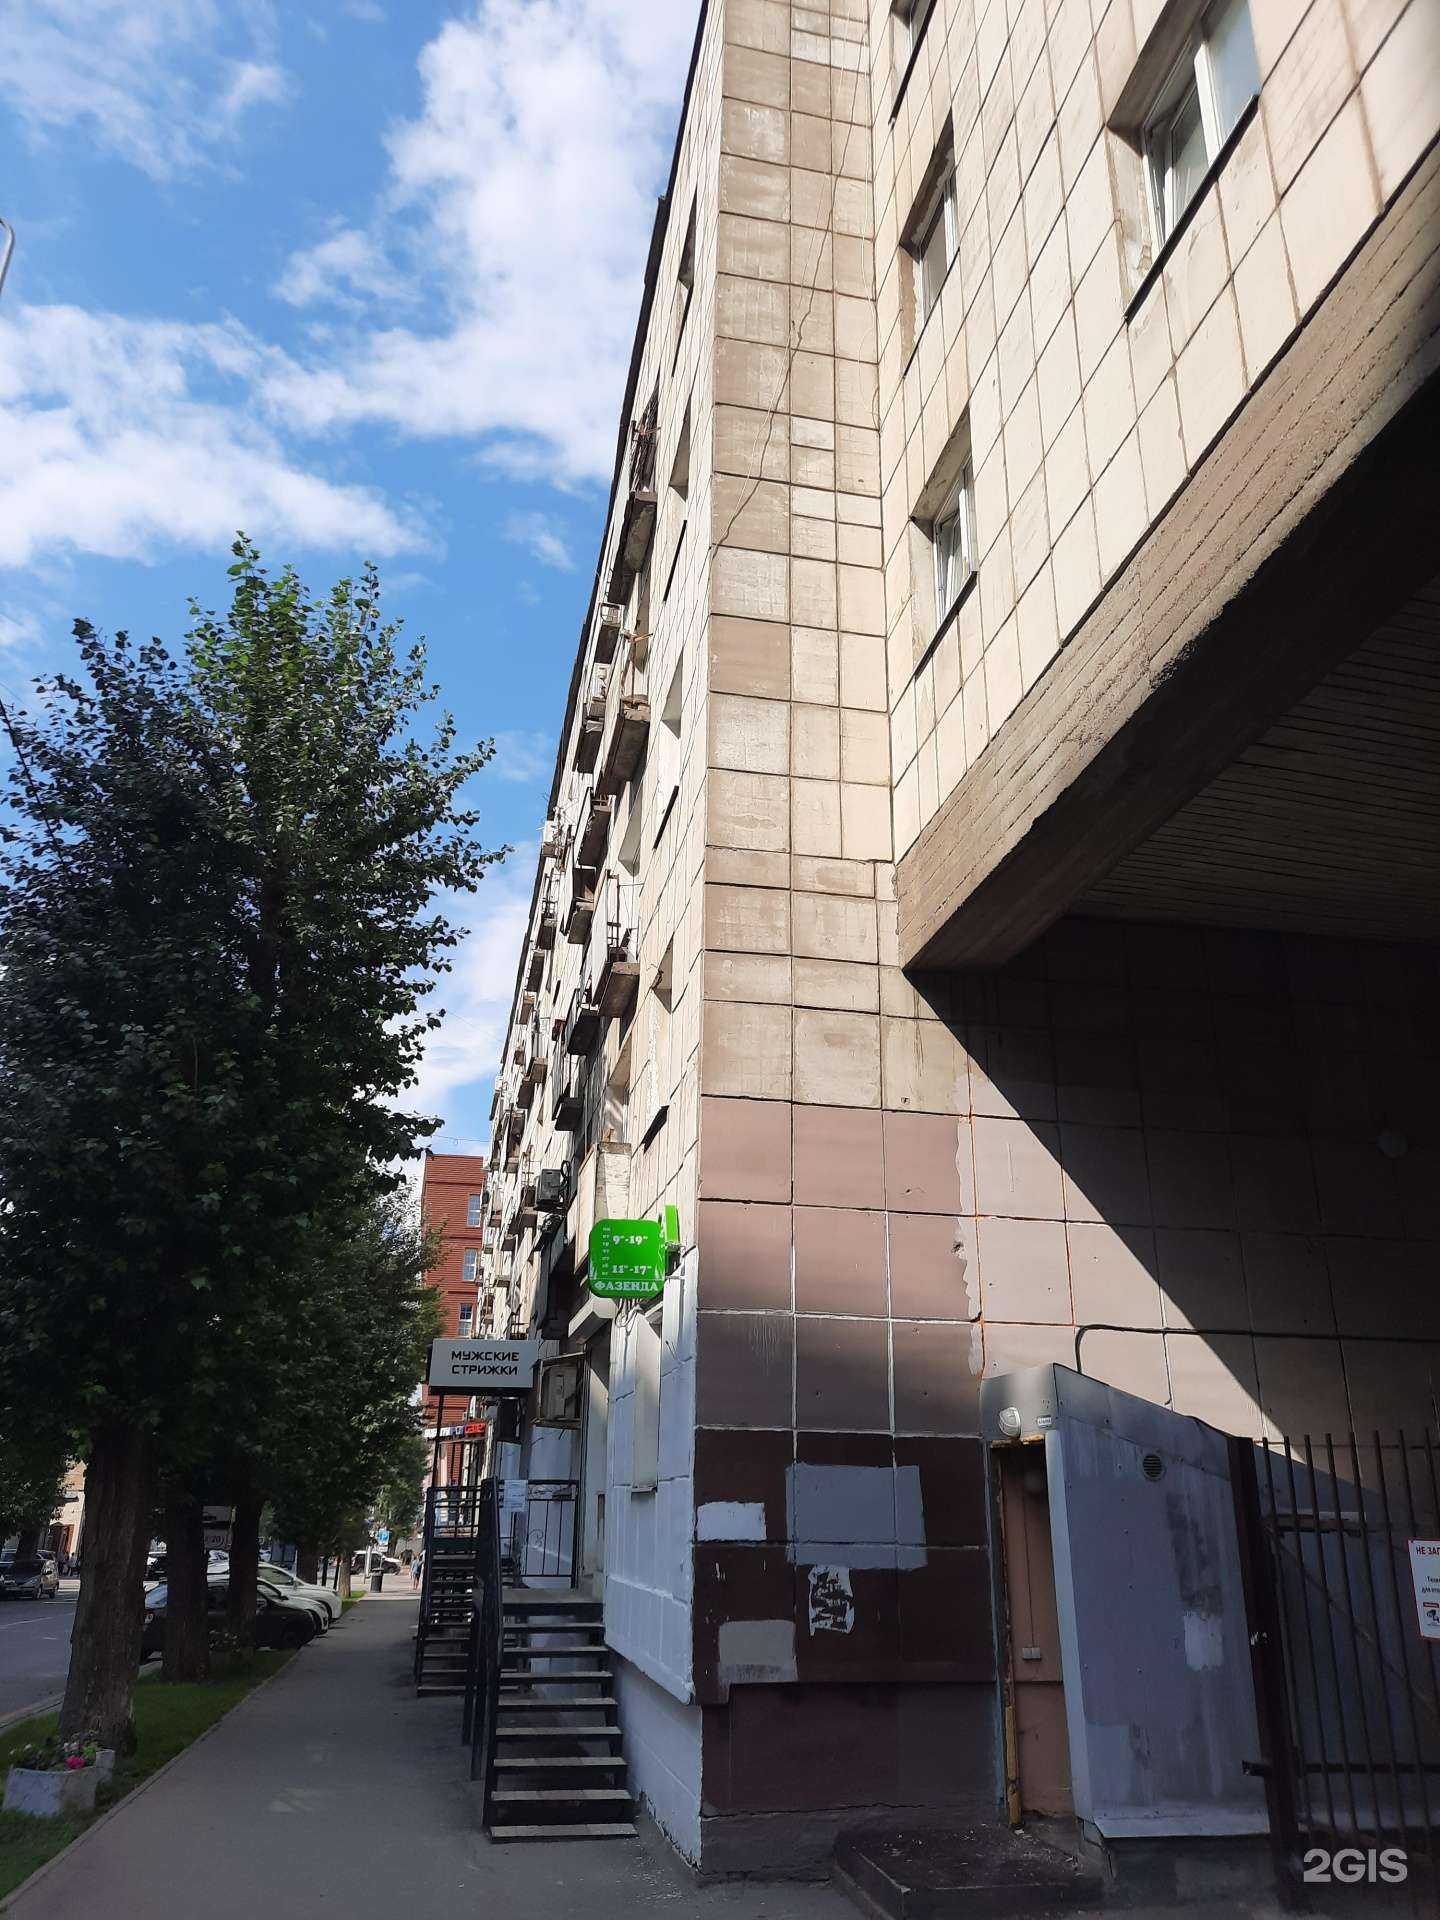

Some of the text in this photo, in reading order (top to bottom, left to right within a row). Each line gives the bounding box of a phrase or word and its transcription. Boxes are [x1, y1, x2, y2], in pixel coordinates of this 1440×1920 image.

[594, 1281, 658, 1292] ФАЗЕНДА
[451, 1350, 520, 1362] МУЖСКИЕ
[451, 1364, 519, 1376] СТРИЖКИ
